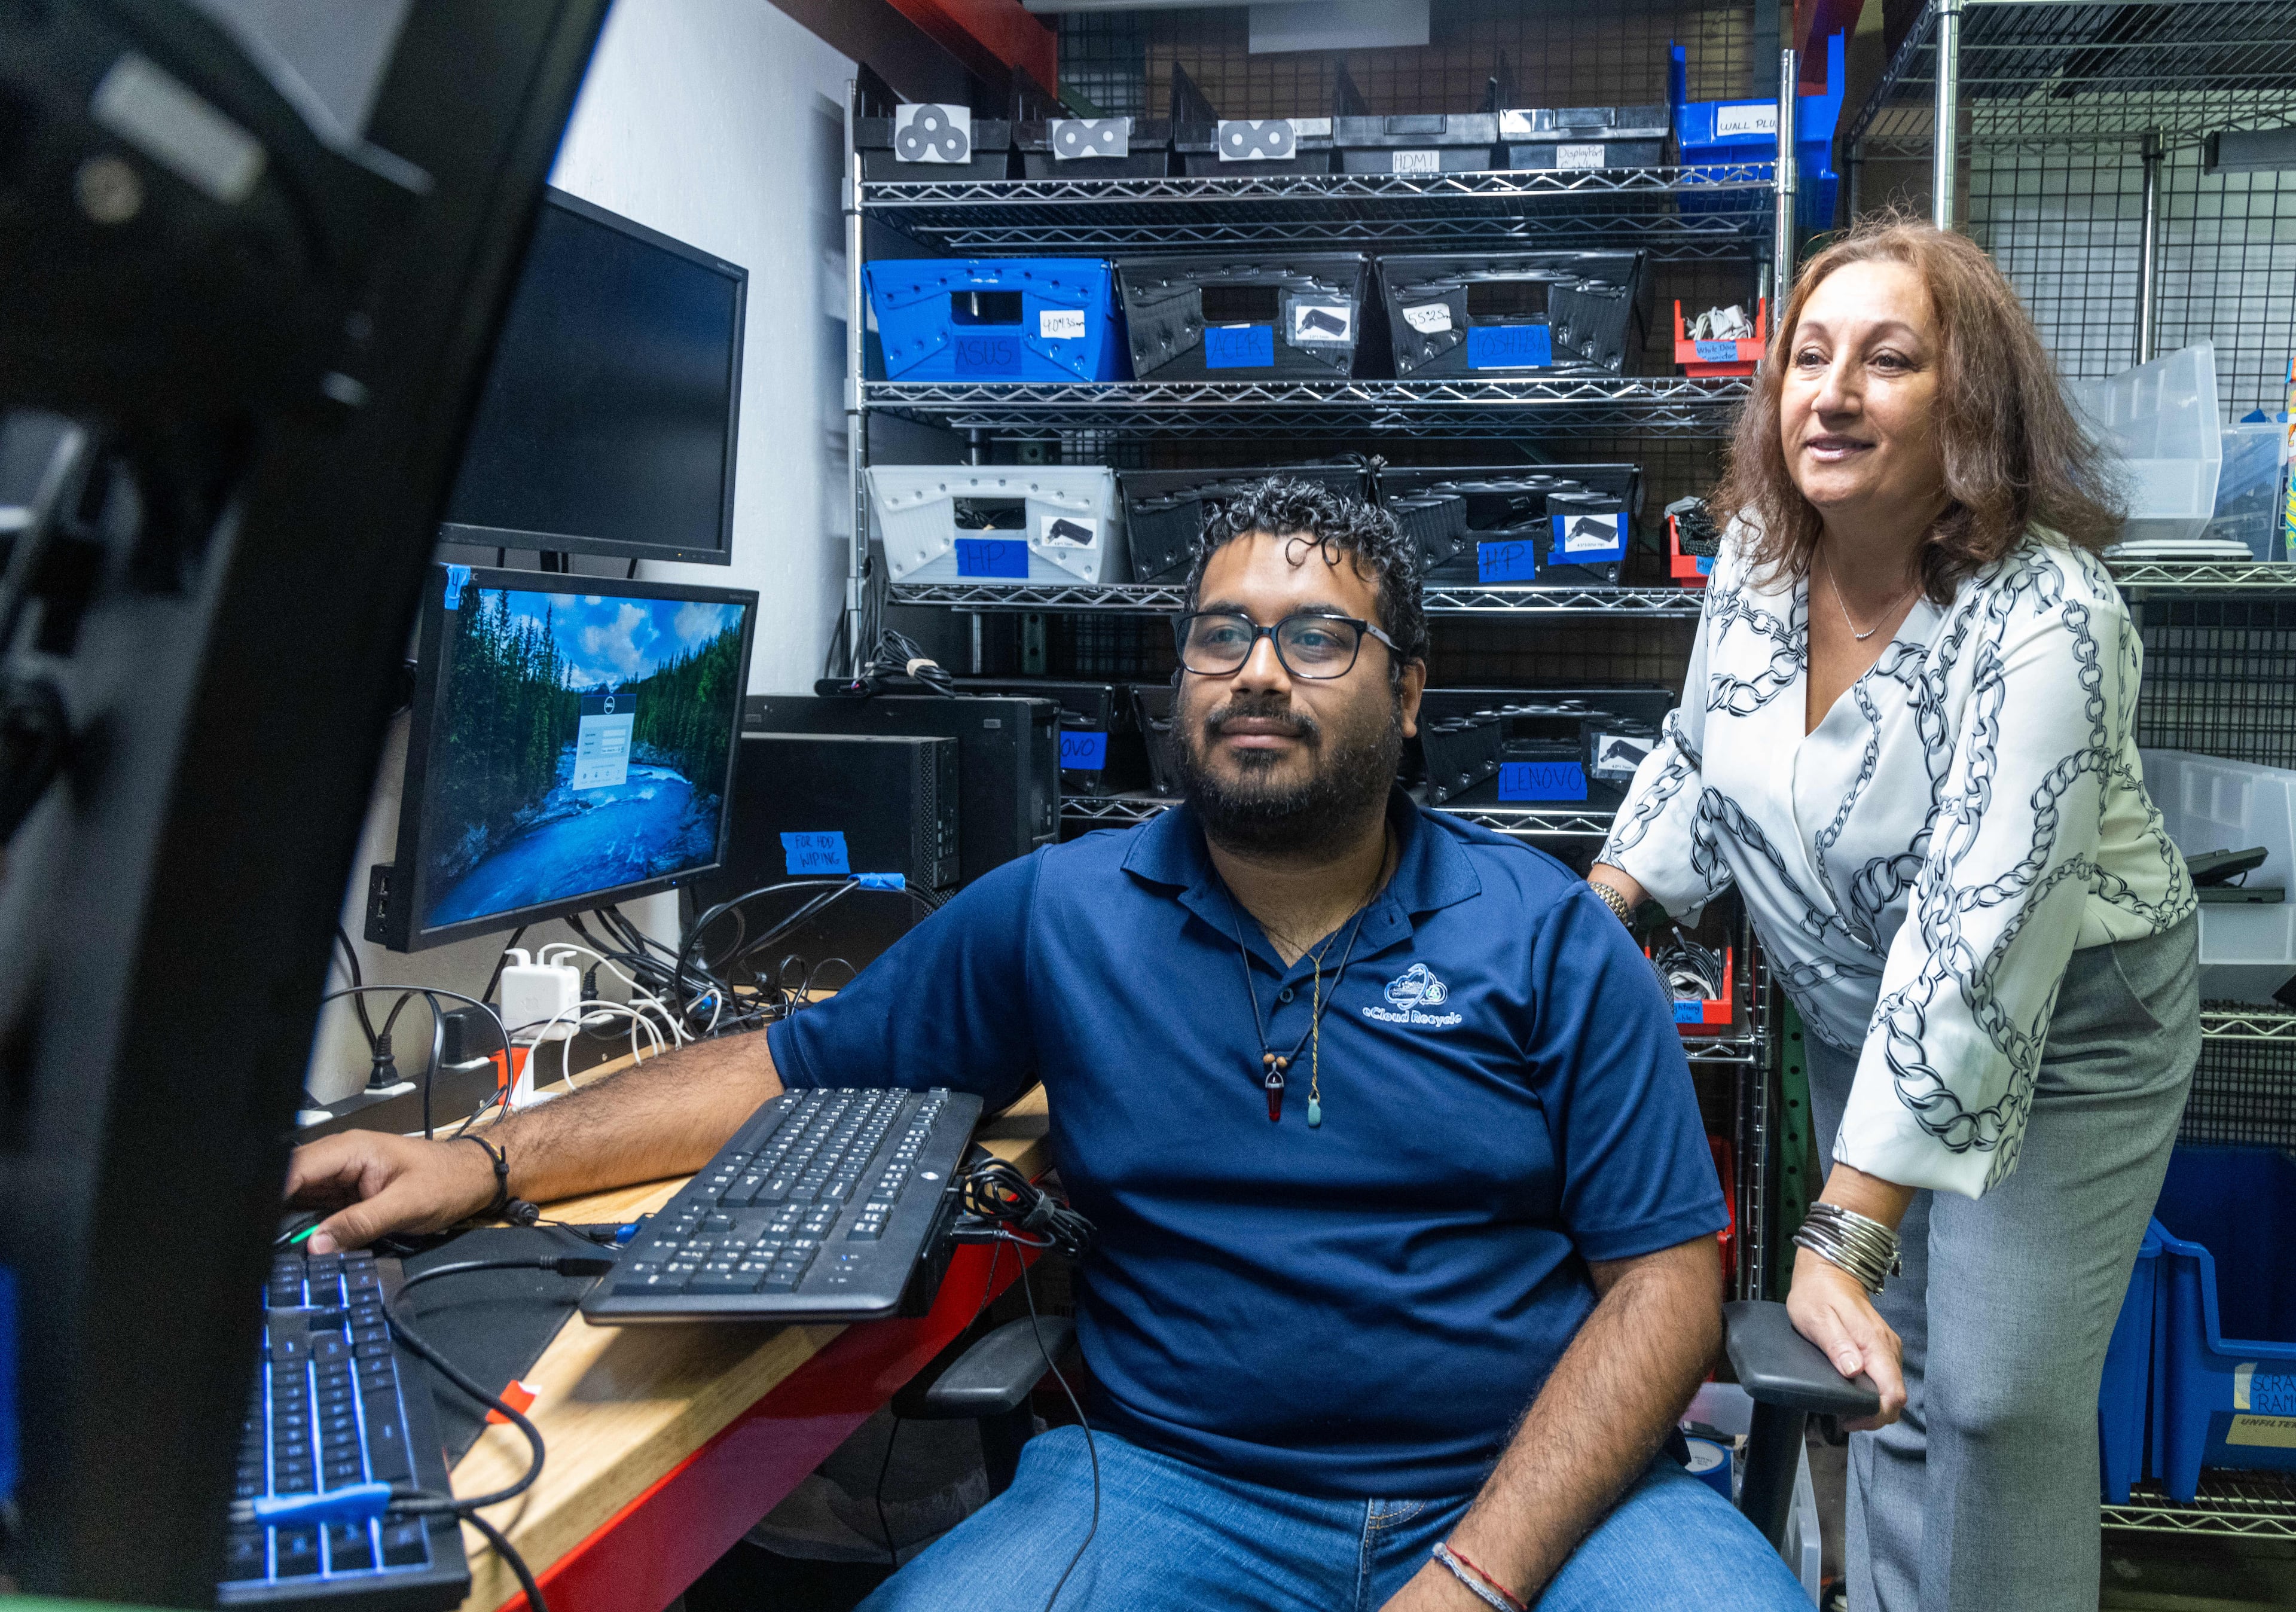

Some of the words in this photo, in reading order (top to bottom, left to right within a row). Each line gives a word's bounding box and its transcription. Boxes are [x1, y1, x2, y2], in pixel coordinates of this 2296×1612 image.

[1720, 121, 1750, 130] WALL
[1756, 119, 1776, 128] PLU
[1394, 152, 1433, 170] HDMI
[957, 340, 1012, 366] ASUS
[1211, 330, 1263, 359] ACER
[1476, 329, 1546, 358] TOSHIBA
[966, 541, 1005, 572] HP
[1483, 542, 1525, 575] HP
[451, 572, 460, 597] 4
[1061, 738, 1095, 758] OVO
[1504, 765, 1582, 793] LENOVO
[795, 835, 813, 849] FOR
[817, 835, 834, 849] HDD
[799, 851, 841, 868] WIPING
[1362, 1006, 1409, 1023] eCloud
[1411, 1009, 1463, 1028] Recycle
[2252, 1375, 2296, 1393] SCRA
[2257, 1394, 2296, 1413] RAM
